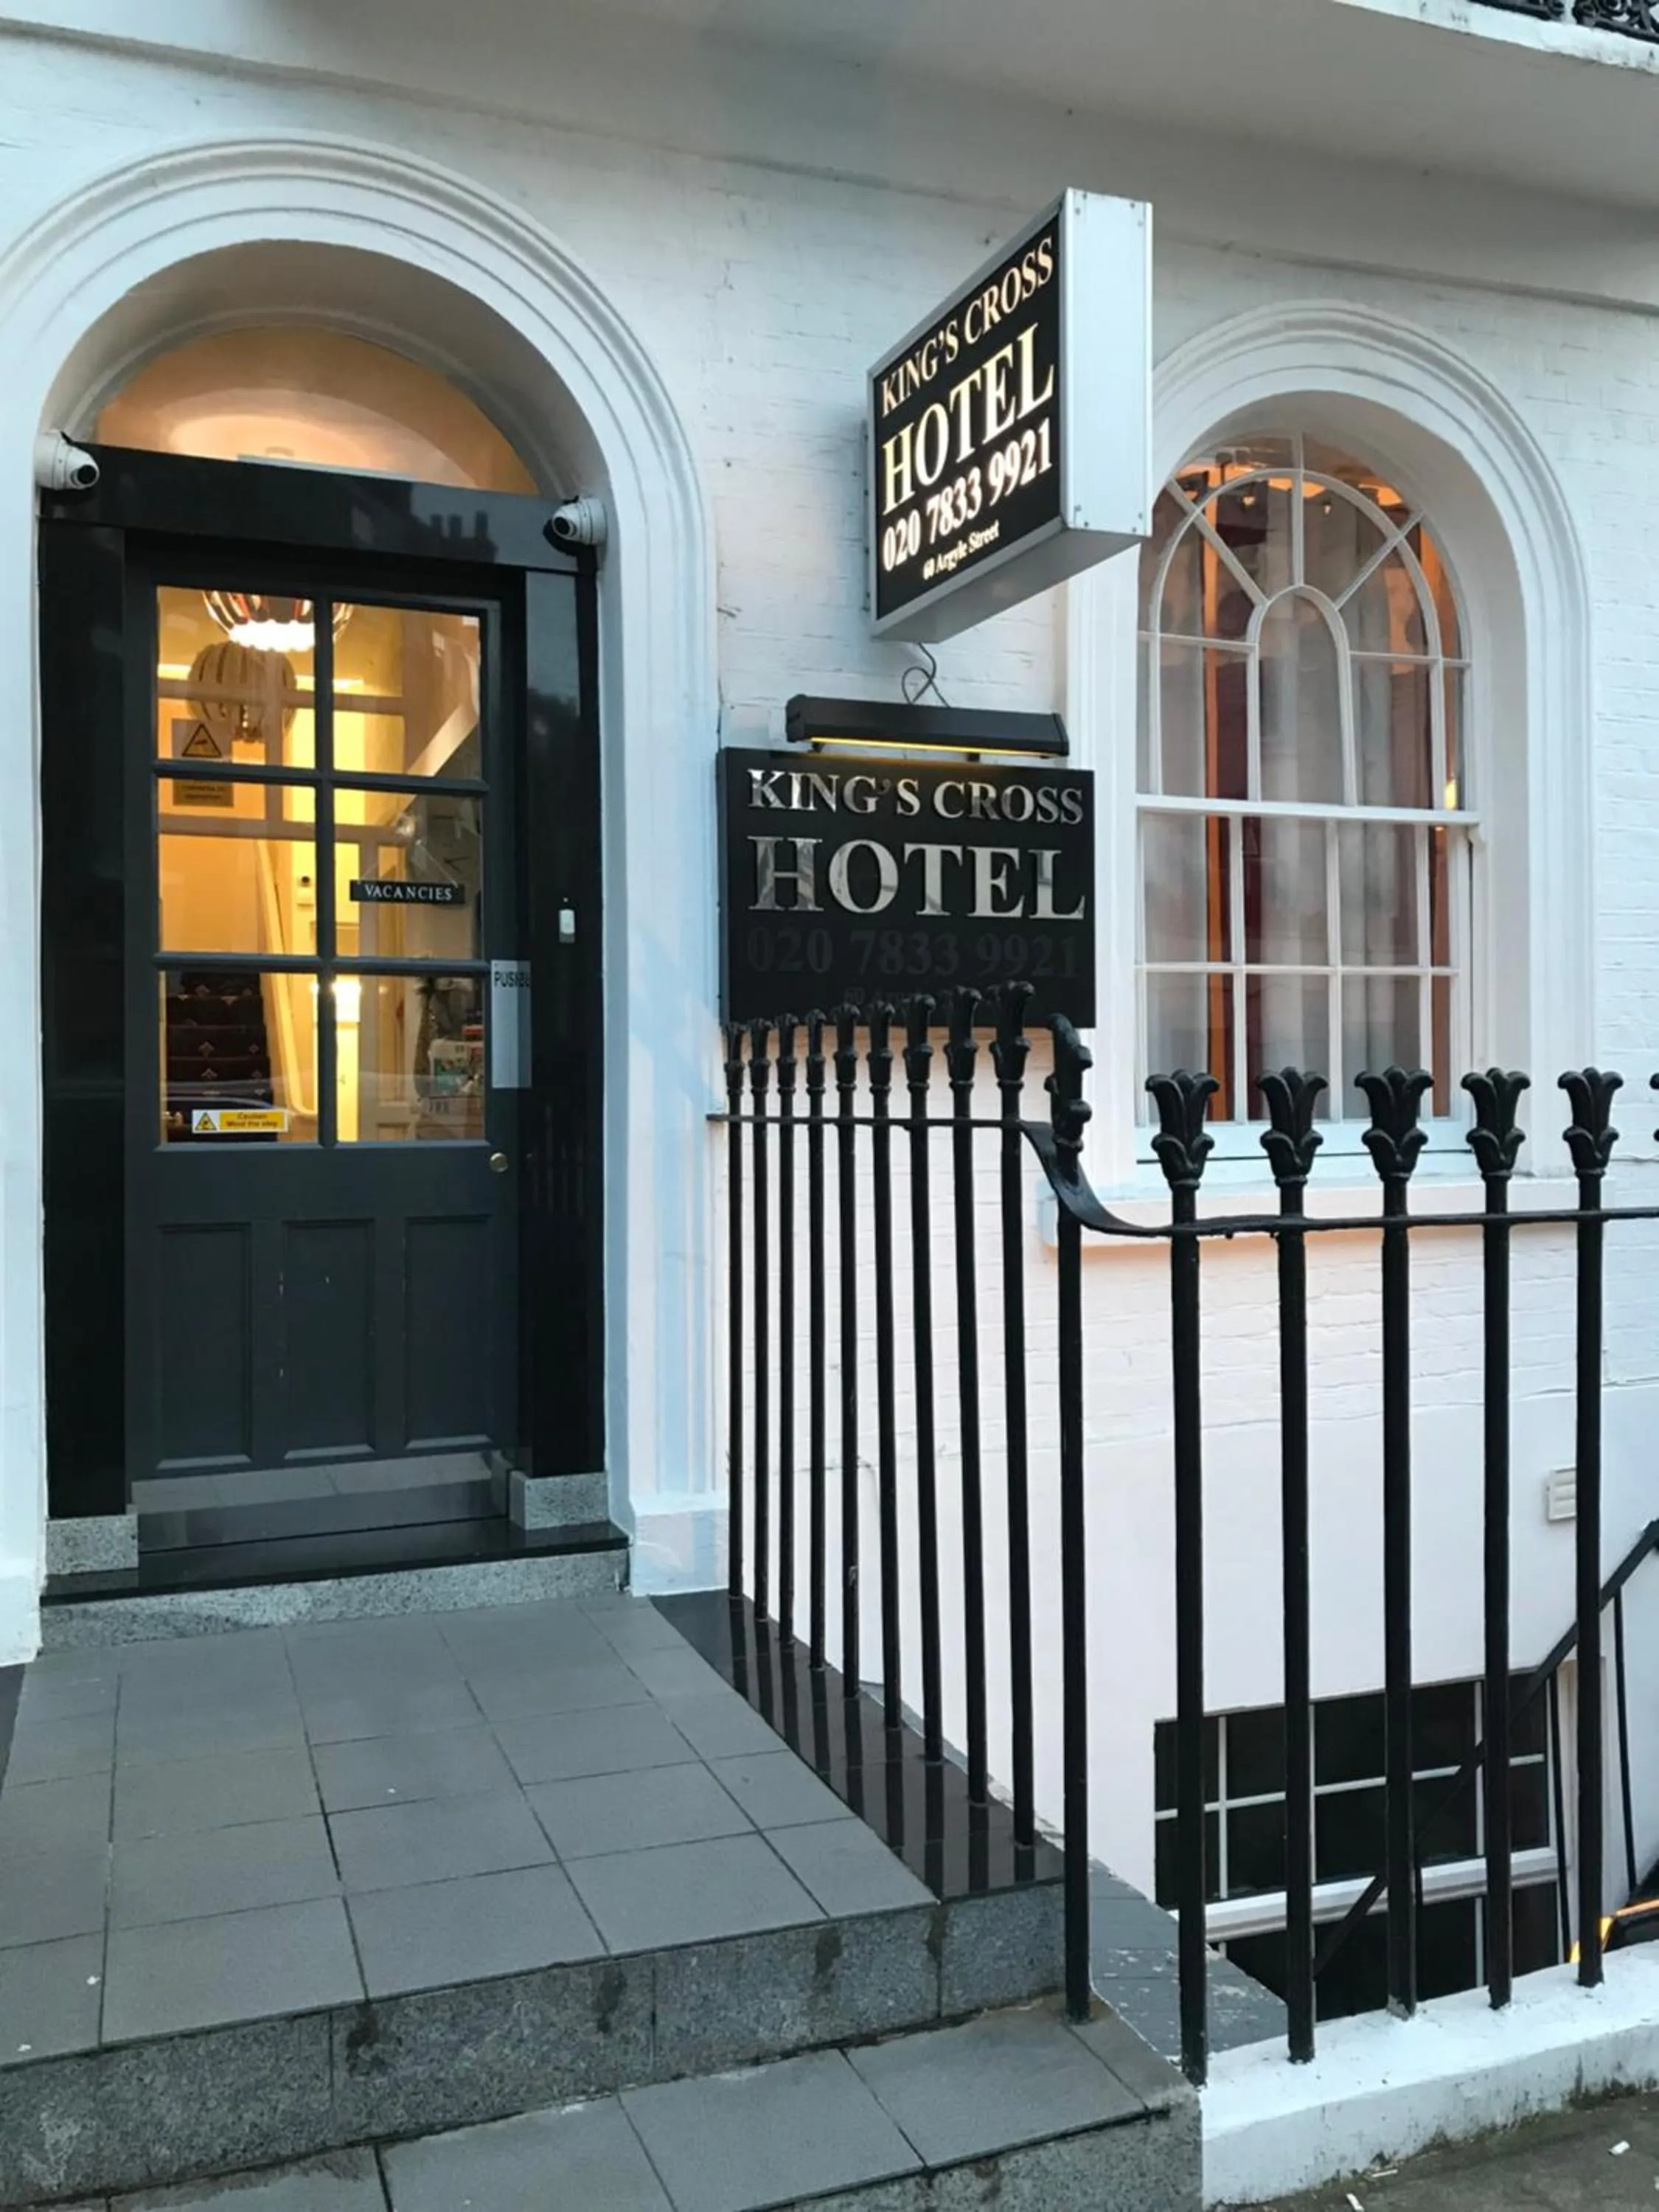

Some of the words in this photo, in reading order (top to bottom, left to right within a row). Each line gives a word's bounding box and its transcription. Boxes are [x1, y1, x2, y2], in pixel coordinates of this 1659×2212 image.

[881, 320, 958, 418] KING'S
[964, 236, 1054, 344] CROSS
[883, 323, 1054, 515] HOTEL
[883, 509, 921, 571] 020
[925, 467, 982, 544] 7833
[988, 417, 1052, 507] 9921
[968, 519, 999, 553] Street
[747, 768, 921, 816] KING'S
[933, 781, 1084, 824] CROSS
[364, 884, 453, 901] VACANCIES
[747, 835, 1086, 919] HOTEL
[748, 926, 833, 973] 020
[849, 929, 959, 976] 7833
[975, 932, 1079, 978] 9921
